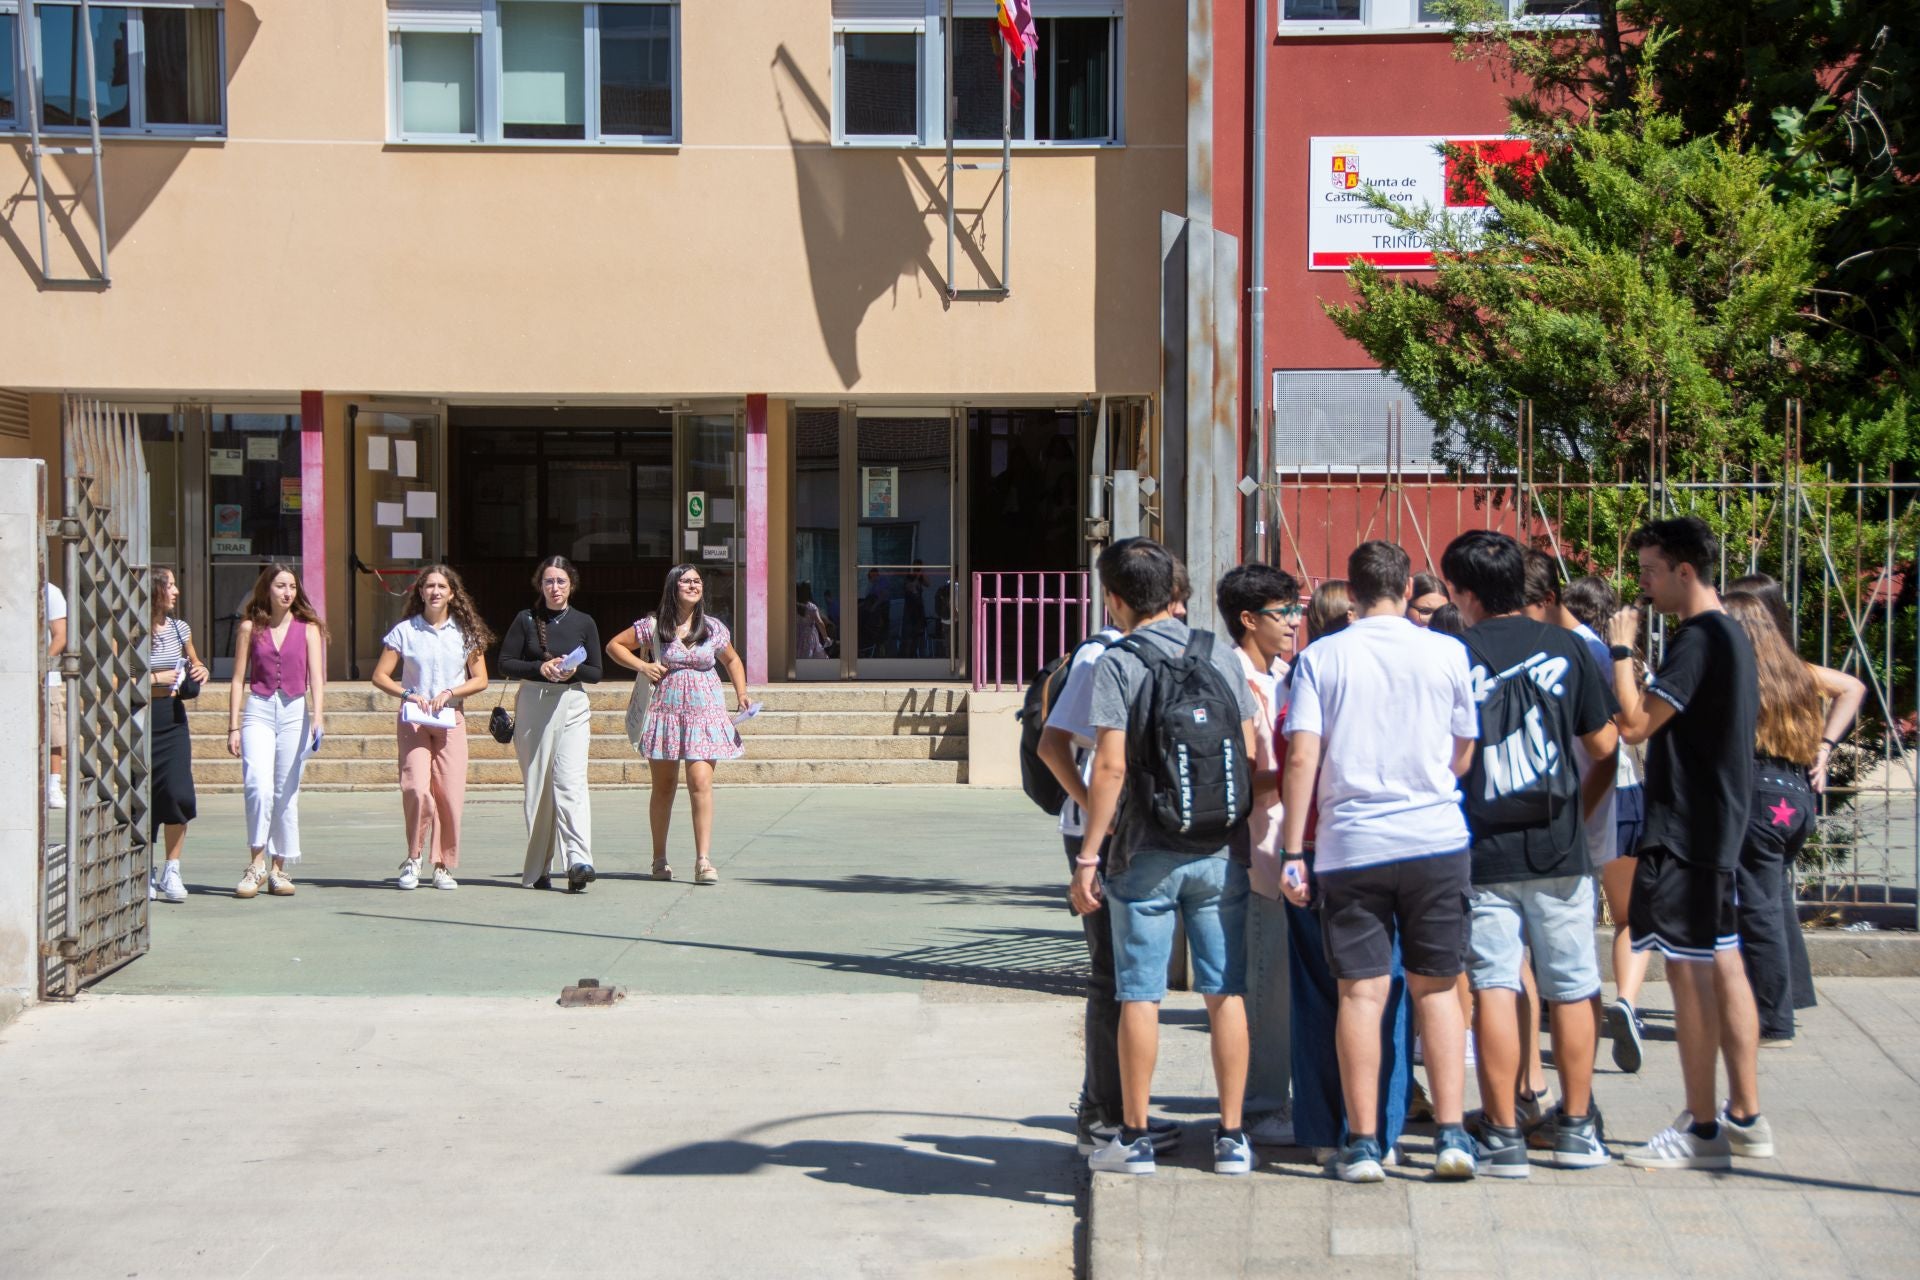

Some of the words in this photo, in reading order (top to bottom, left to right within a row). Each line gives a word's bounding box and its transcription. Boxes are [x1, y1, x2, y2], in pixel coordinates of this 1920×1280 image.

[1401, 177, 1417, 187] de
[1389, 191, 1413, 202] eón
[1336, 213, 1393, 224] INSTITUTO
[216, 543, 247, 552] TIRAR
[1178, 753, 1189, 776] FILA
[1182, 786, 1192, 809] FILA
